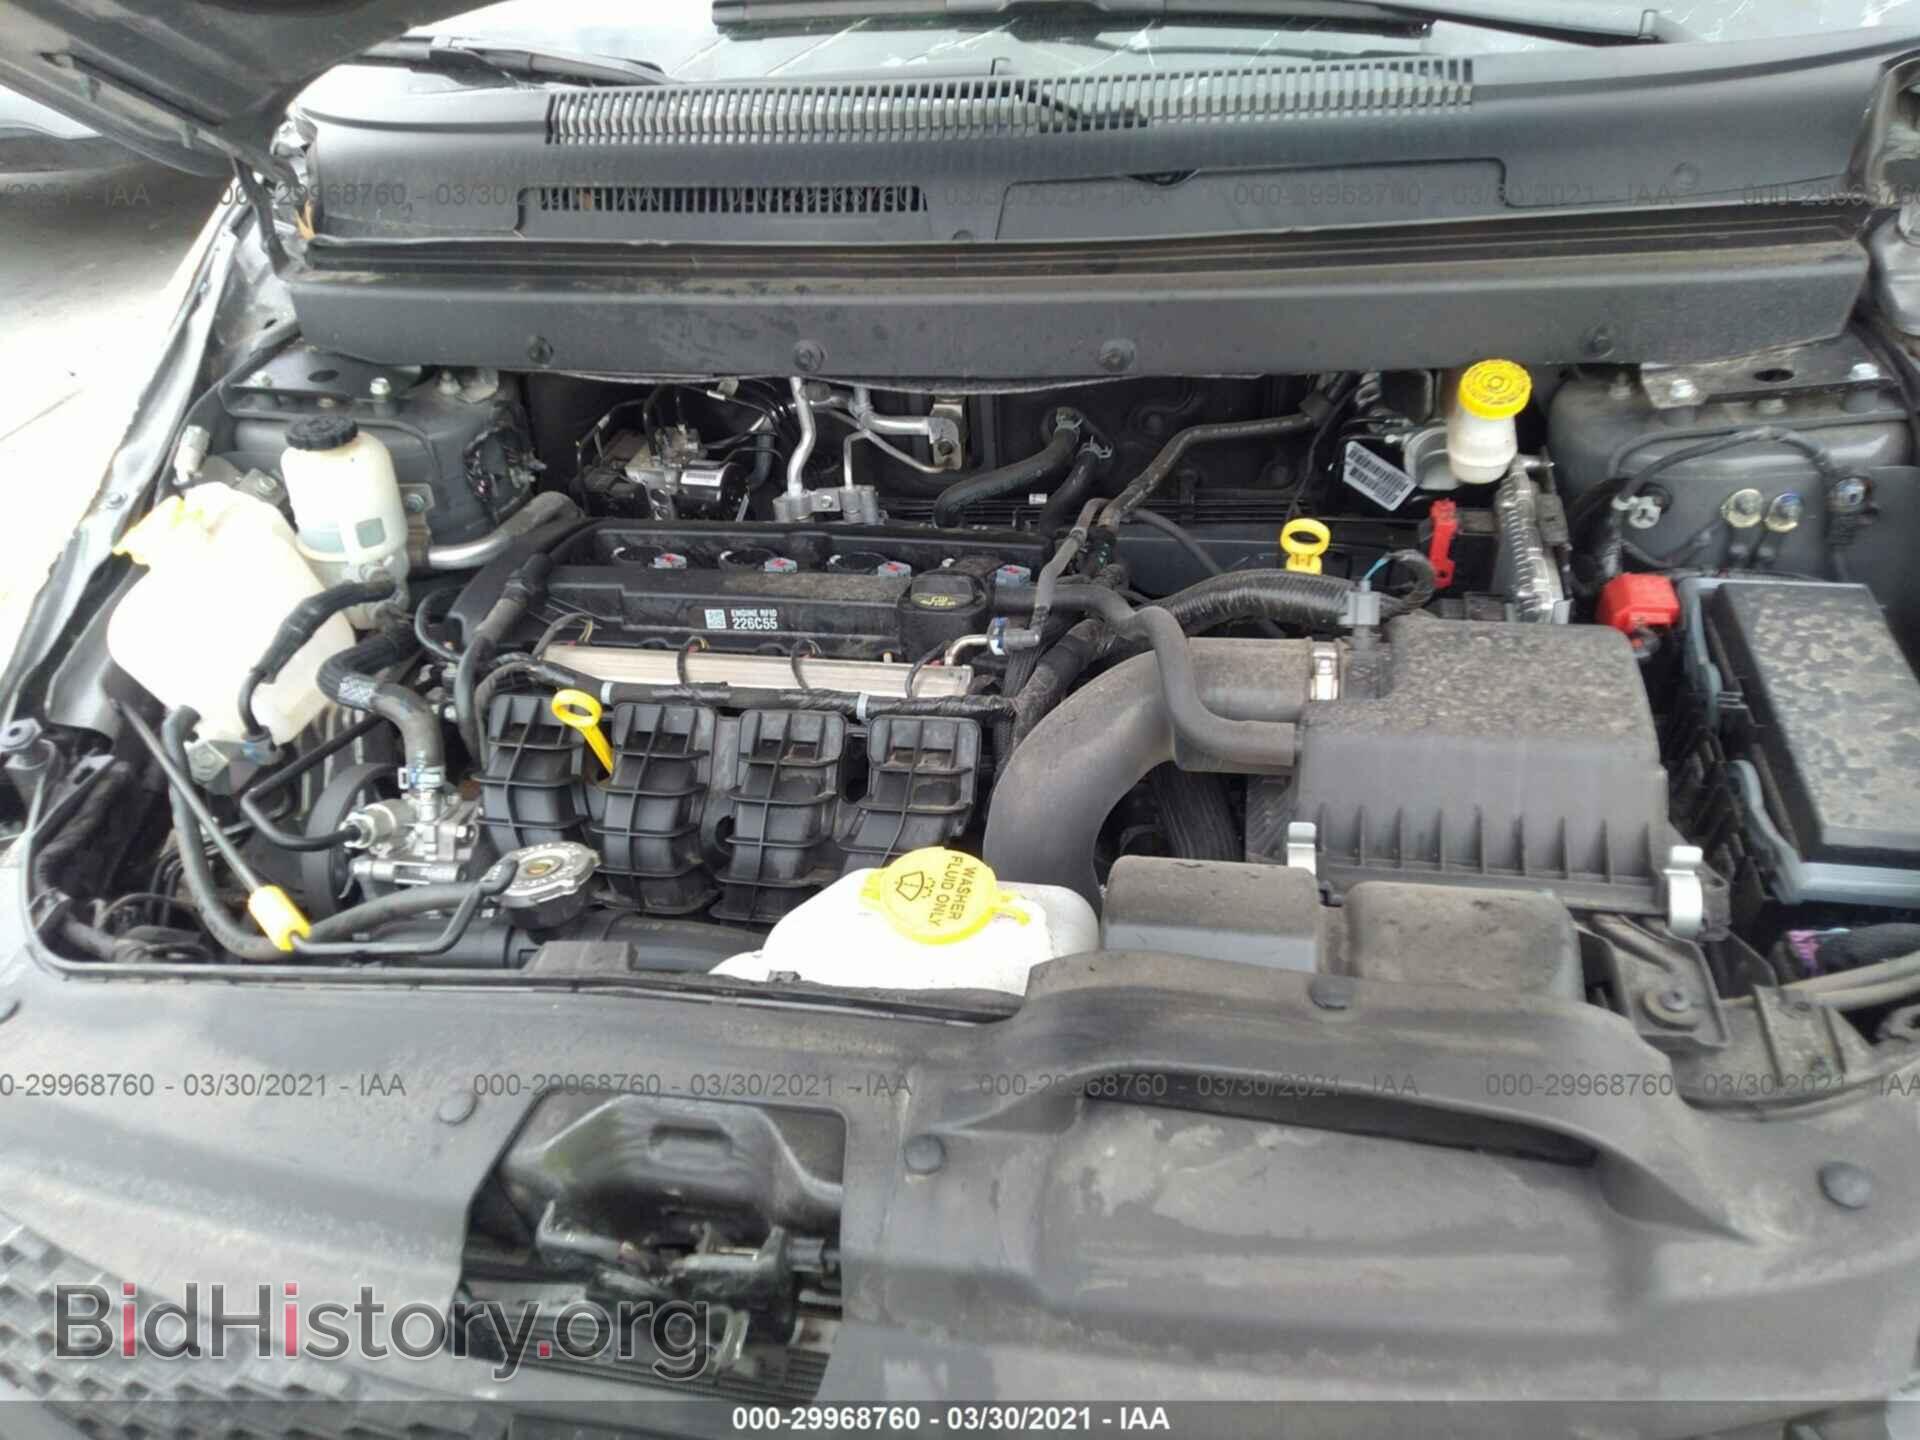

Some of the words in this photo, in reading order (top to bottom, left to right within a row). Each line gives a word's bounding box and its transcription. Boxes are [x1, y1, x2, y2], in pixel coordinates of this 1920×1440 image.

[732, 617, 778, 630] 226C55
[940, 855, 964, 891] FLUID
[950, 866, 977, 920] WASHER
[928, 894, 950, 927] ONLY
